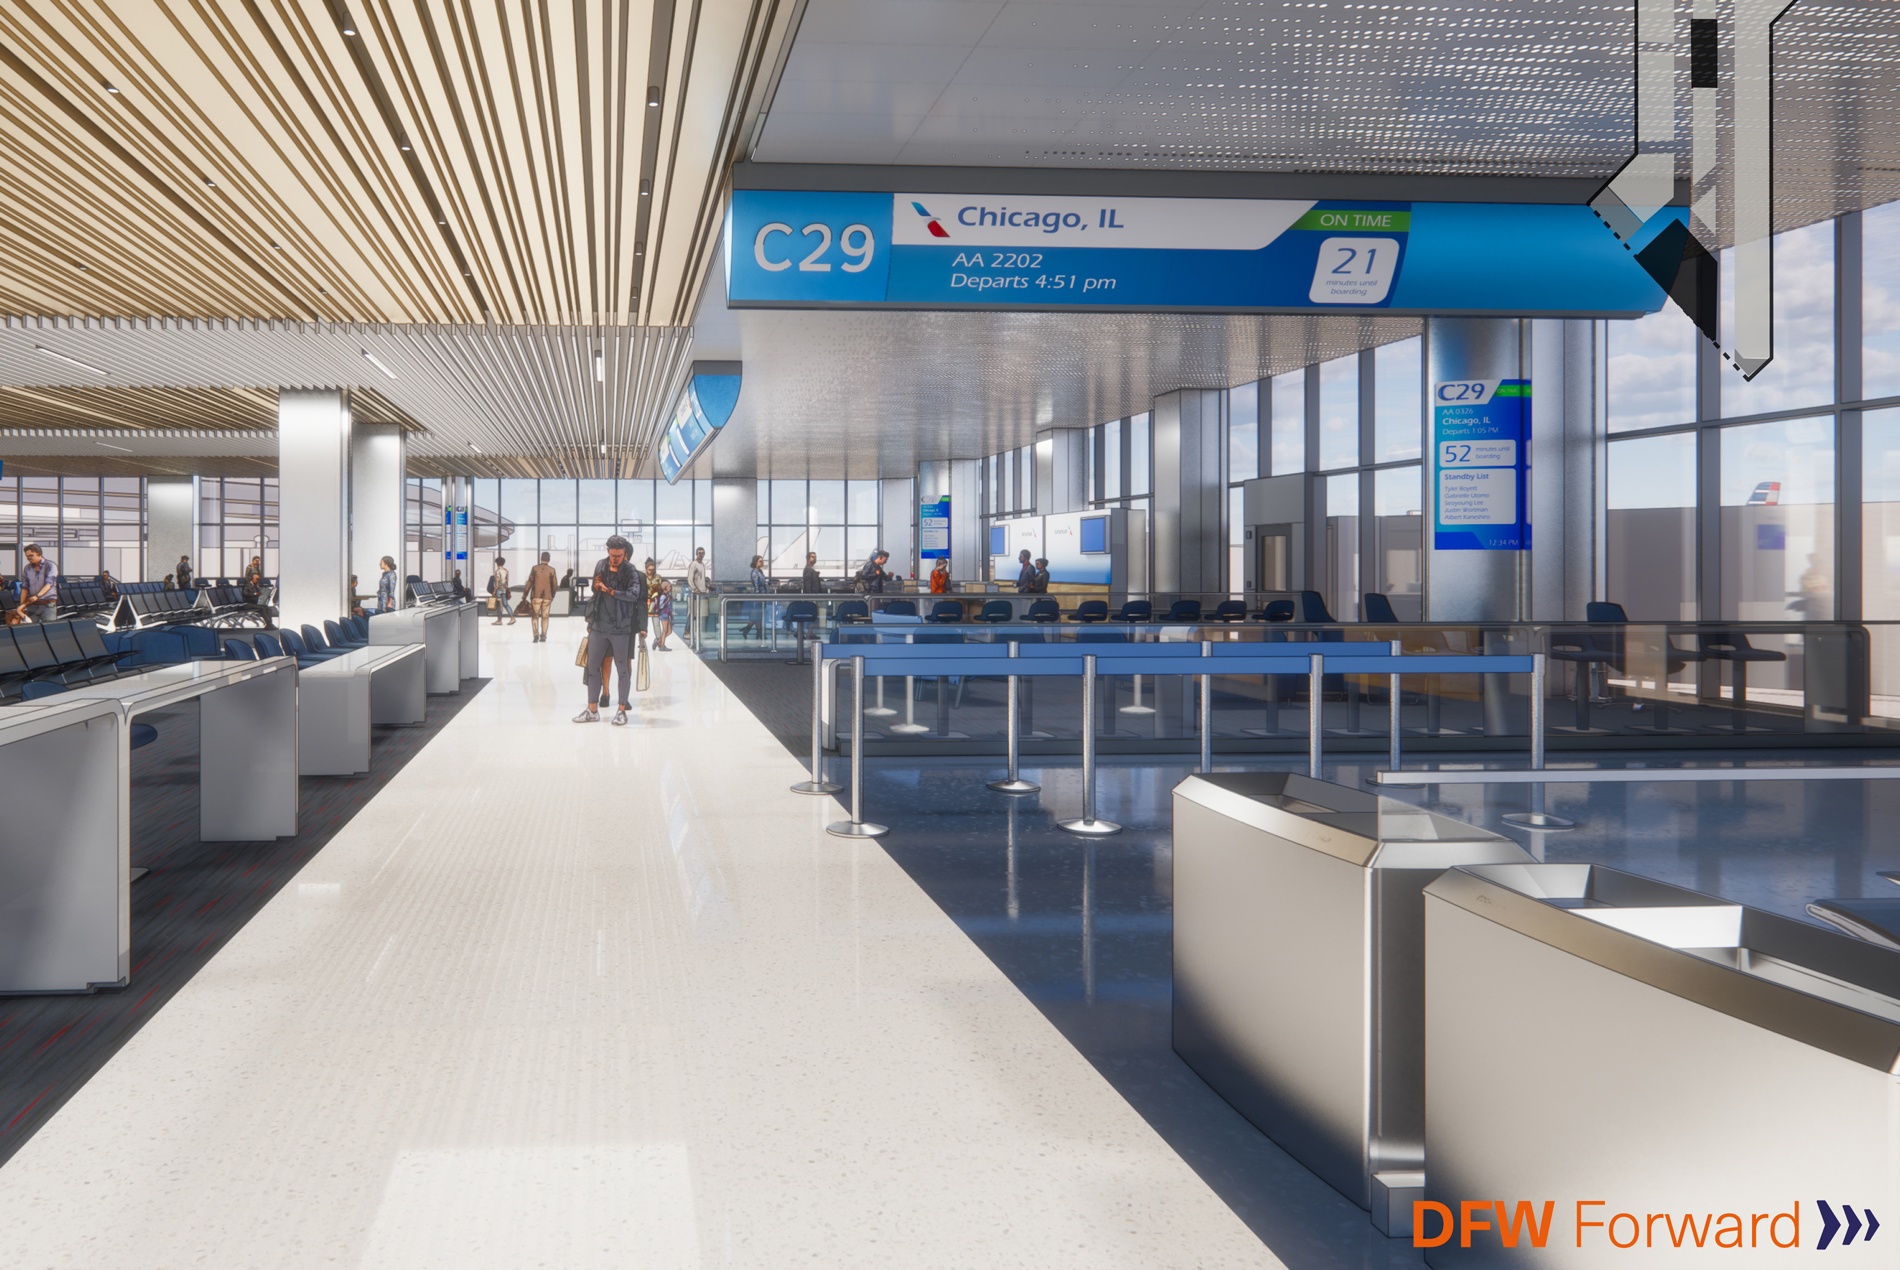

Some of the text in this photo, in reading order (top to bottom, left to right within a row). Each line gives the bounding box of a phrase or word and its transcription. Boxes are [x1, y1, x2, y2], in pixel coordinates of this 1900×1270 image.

[957, 206, 1124, 234] Chicago, IL
[1320, 213, 1392, 227] ON TIME
[754, 222, 875, 273] C29
[951, 253, 1043, 268] AA 2202
[1331, 247, 1377, 275] 21
[950, 273, 1117, 293] Departs 4:51 pm
[1359, 279, 1378, 287] until
[1330, 288, 1367, 297] boarding
[1437, 383, 1485, 401] C29
[1442, 416, 1491, 426] Chicago, IL
[1442, 428, 1470, 436] Departs
[1445, 445, 1471, 463] 52
[1444, 473, 1475, 481] Standby
